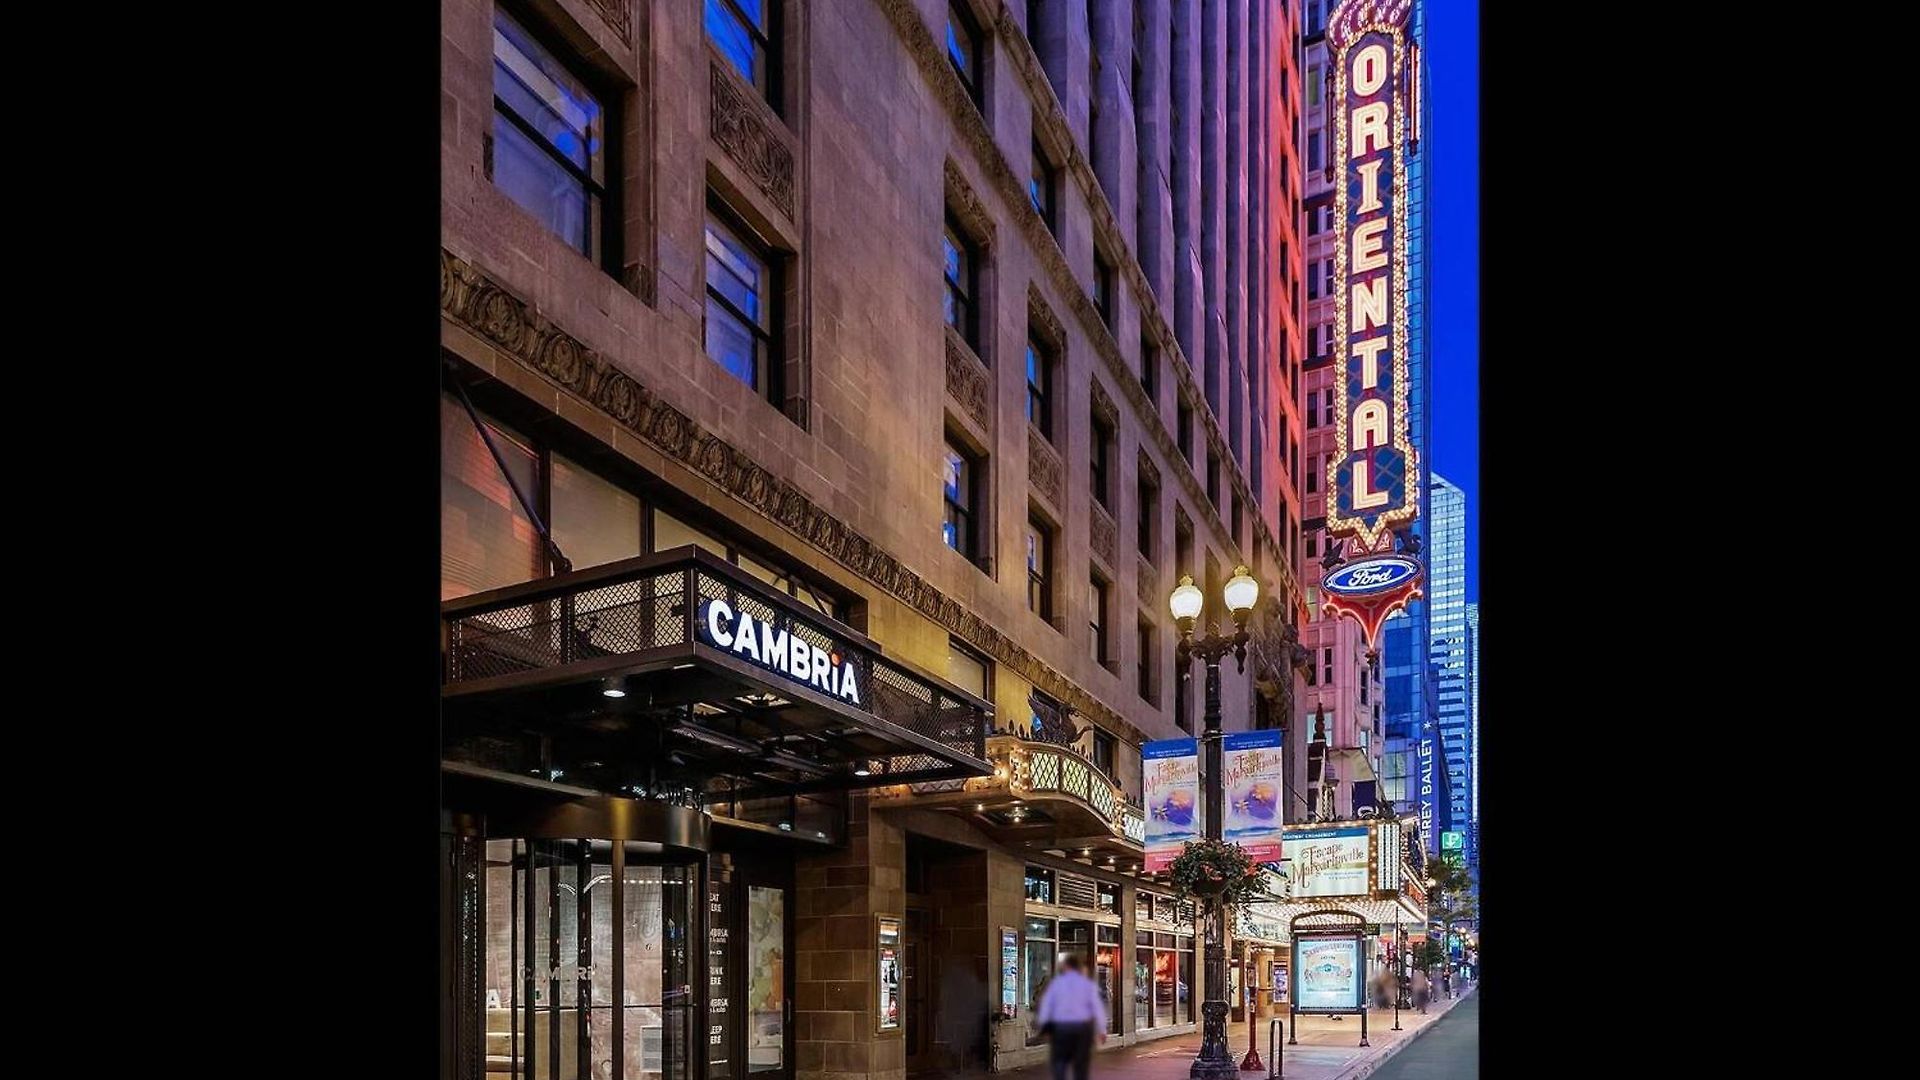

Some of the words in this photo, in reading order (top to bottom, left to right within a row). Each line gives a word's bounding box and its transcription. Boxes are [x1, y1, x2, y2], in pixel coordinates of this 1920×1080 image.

[1352, 44, 1392, 510] ORIENTAL
[1348, 566, 1393, 587] Ford
[1422, 739, 1432, 794] BALLET
[1422, 800, 1432, 841] FREY
